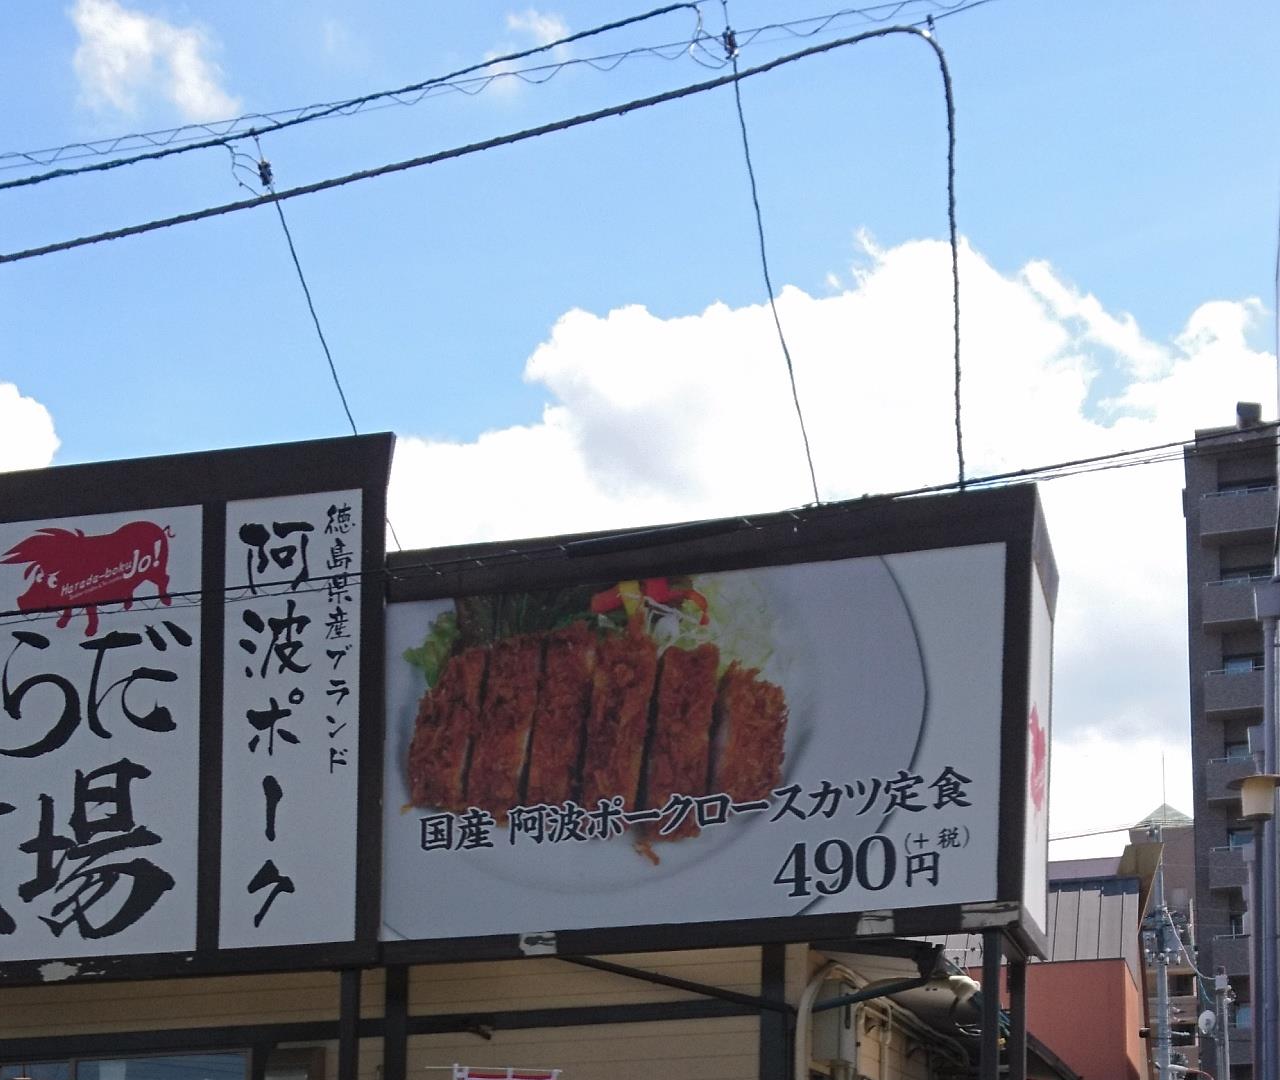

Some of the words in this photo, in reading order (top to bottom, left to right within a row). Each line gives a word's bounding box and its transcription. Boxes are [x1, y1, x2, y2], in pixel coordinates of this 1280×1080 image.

[239, 520, 314, 928] 阿波ポーク
[323, 503, 357, 775] 徳島県産ブランド
[419, 809, 495, 852] 国産
[507, 765, 973, 846] 阿波ポークロースカツ定食
